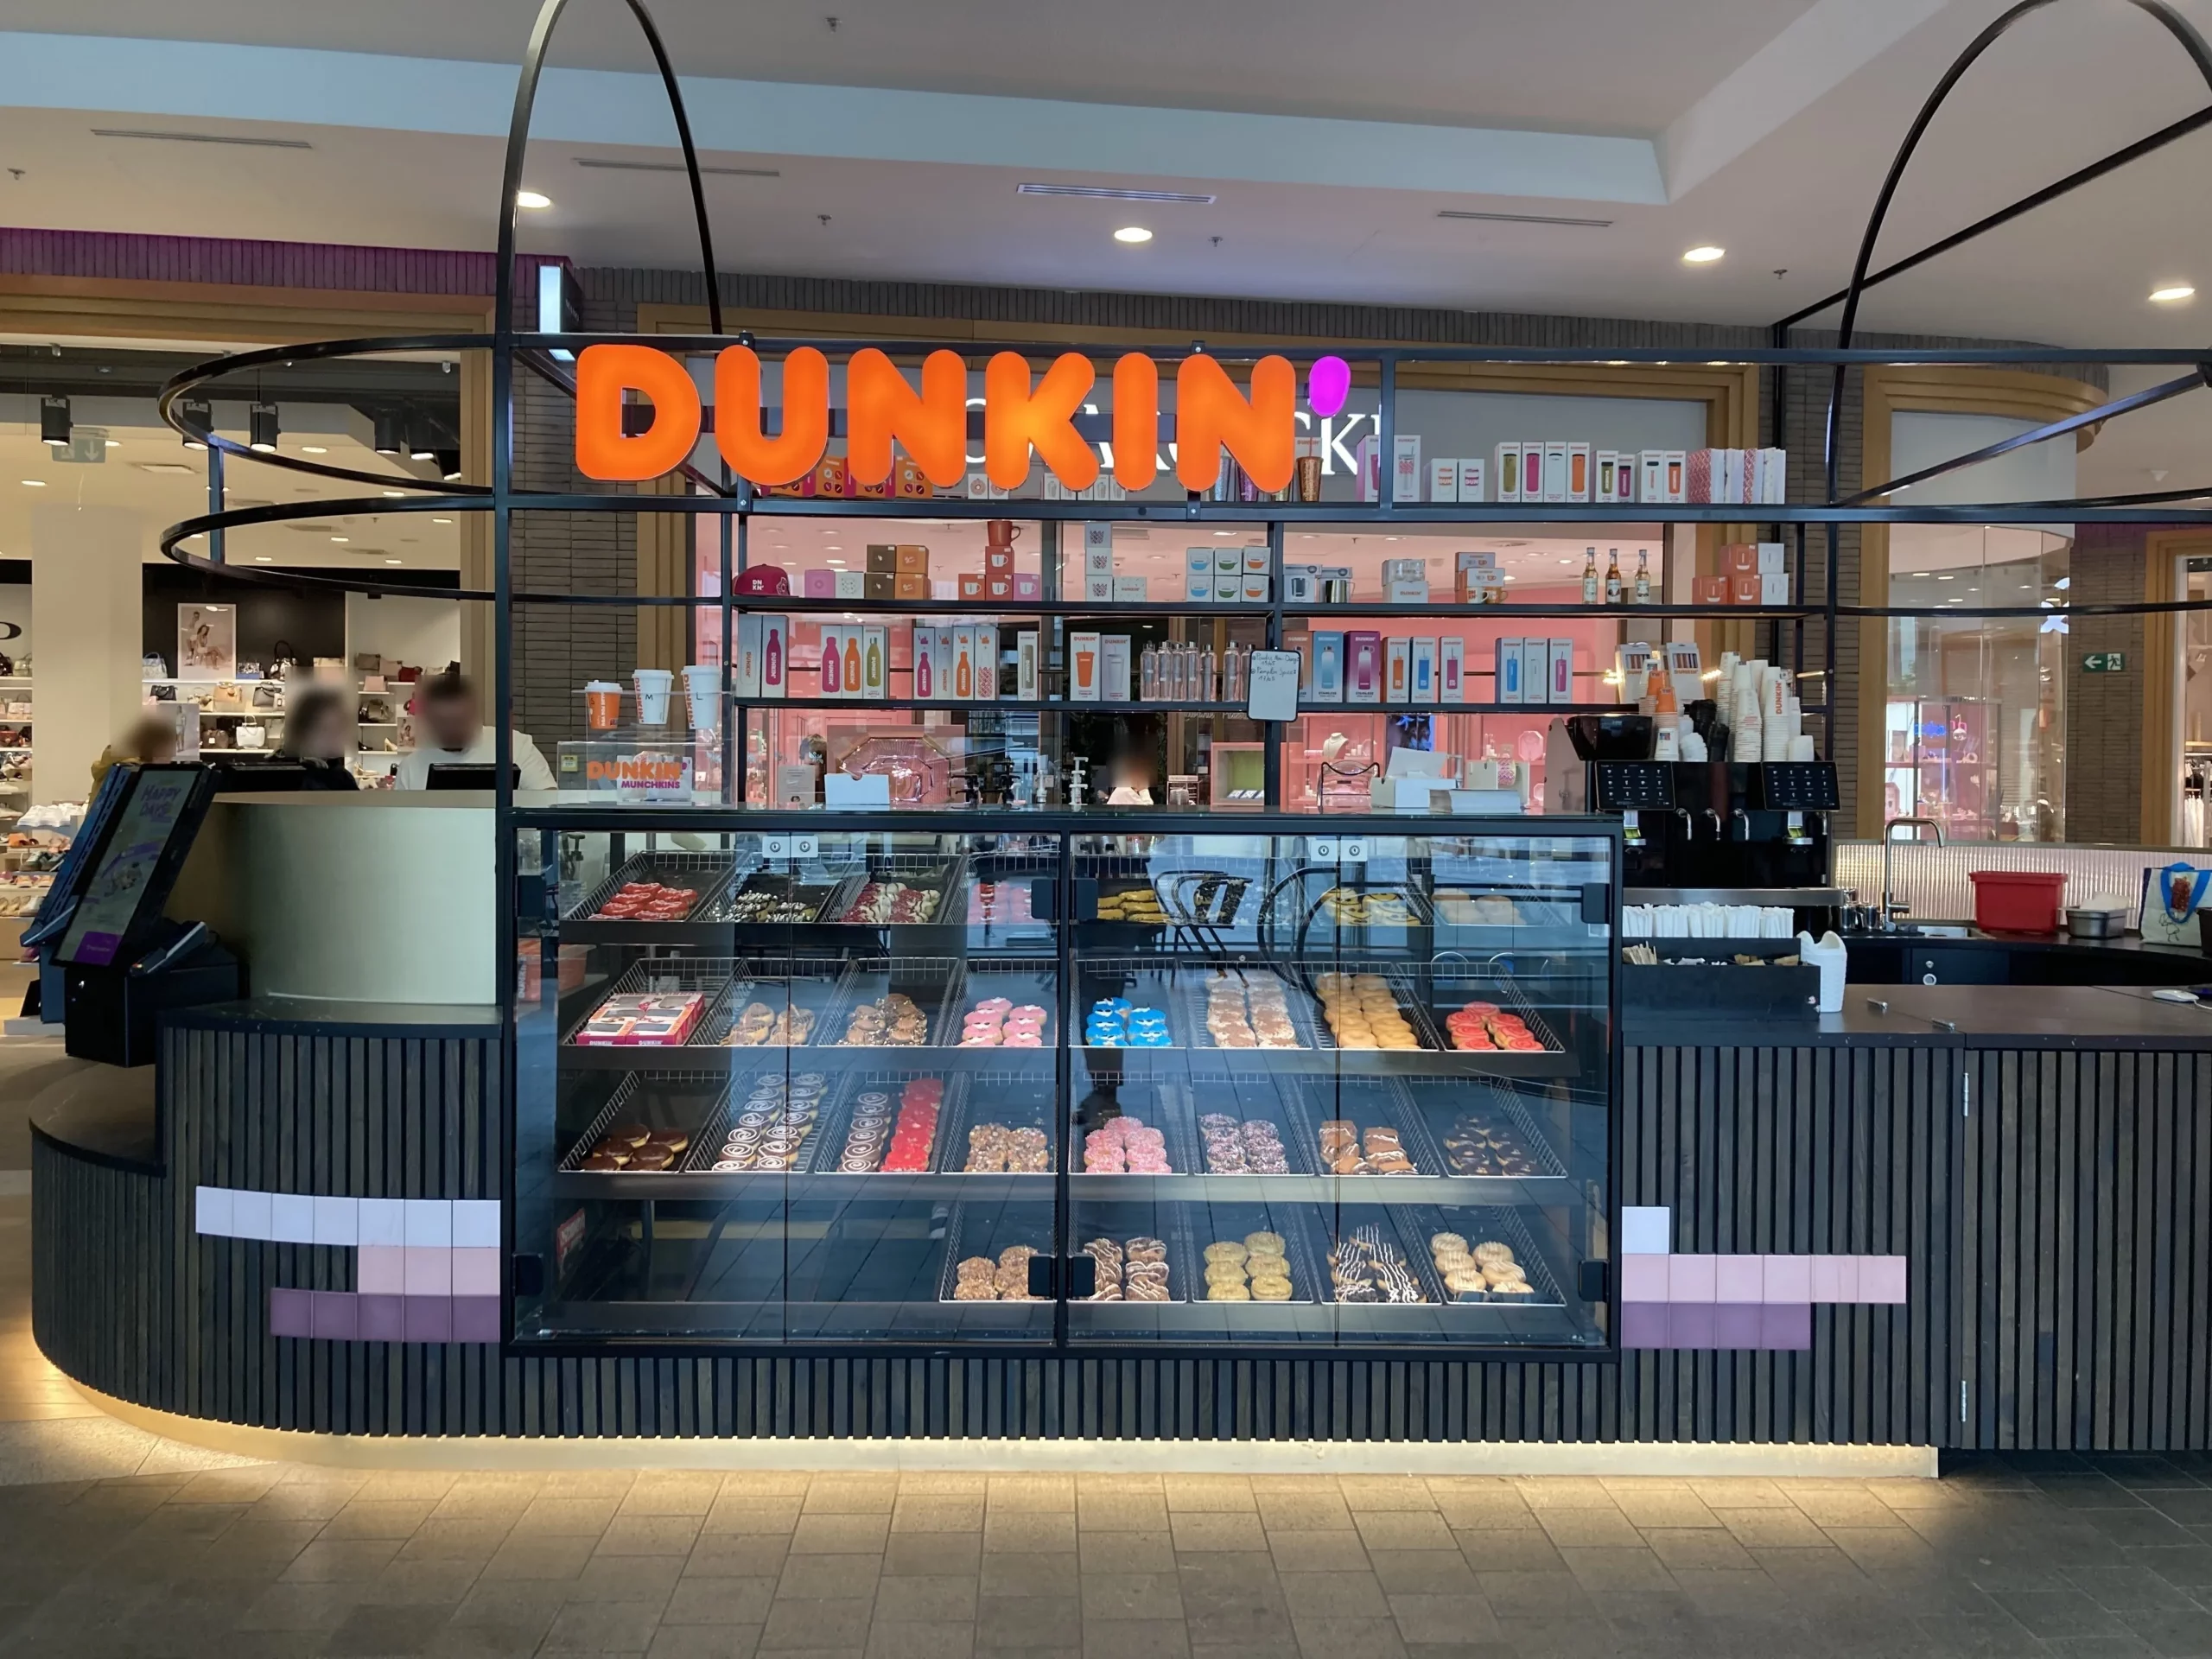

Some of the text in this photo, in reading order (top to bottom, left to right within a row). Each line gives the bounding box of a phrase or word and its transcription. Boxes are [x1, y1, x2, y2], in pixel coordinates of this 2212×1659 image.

[575, 343, 1351, 493] DUNKIN'
[634, 677, 645, 722] DUNKIN'
[684, 674, 696, 728] DUNKIN'
[696, 692, 703, 701] L
[587, 760, 688, 781] DUNKIN'
[620, 780, 681, 789] MUNCHKINS
